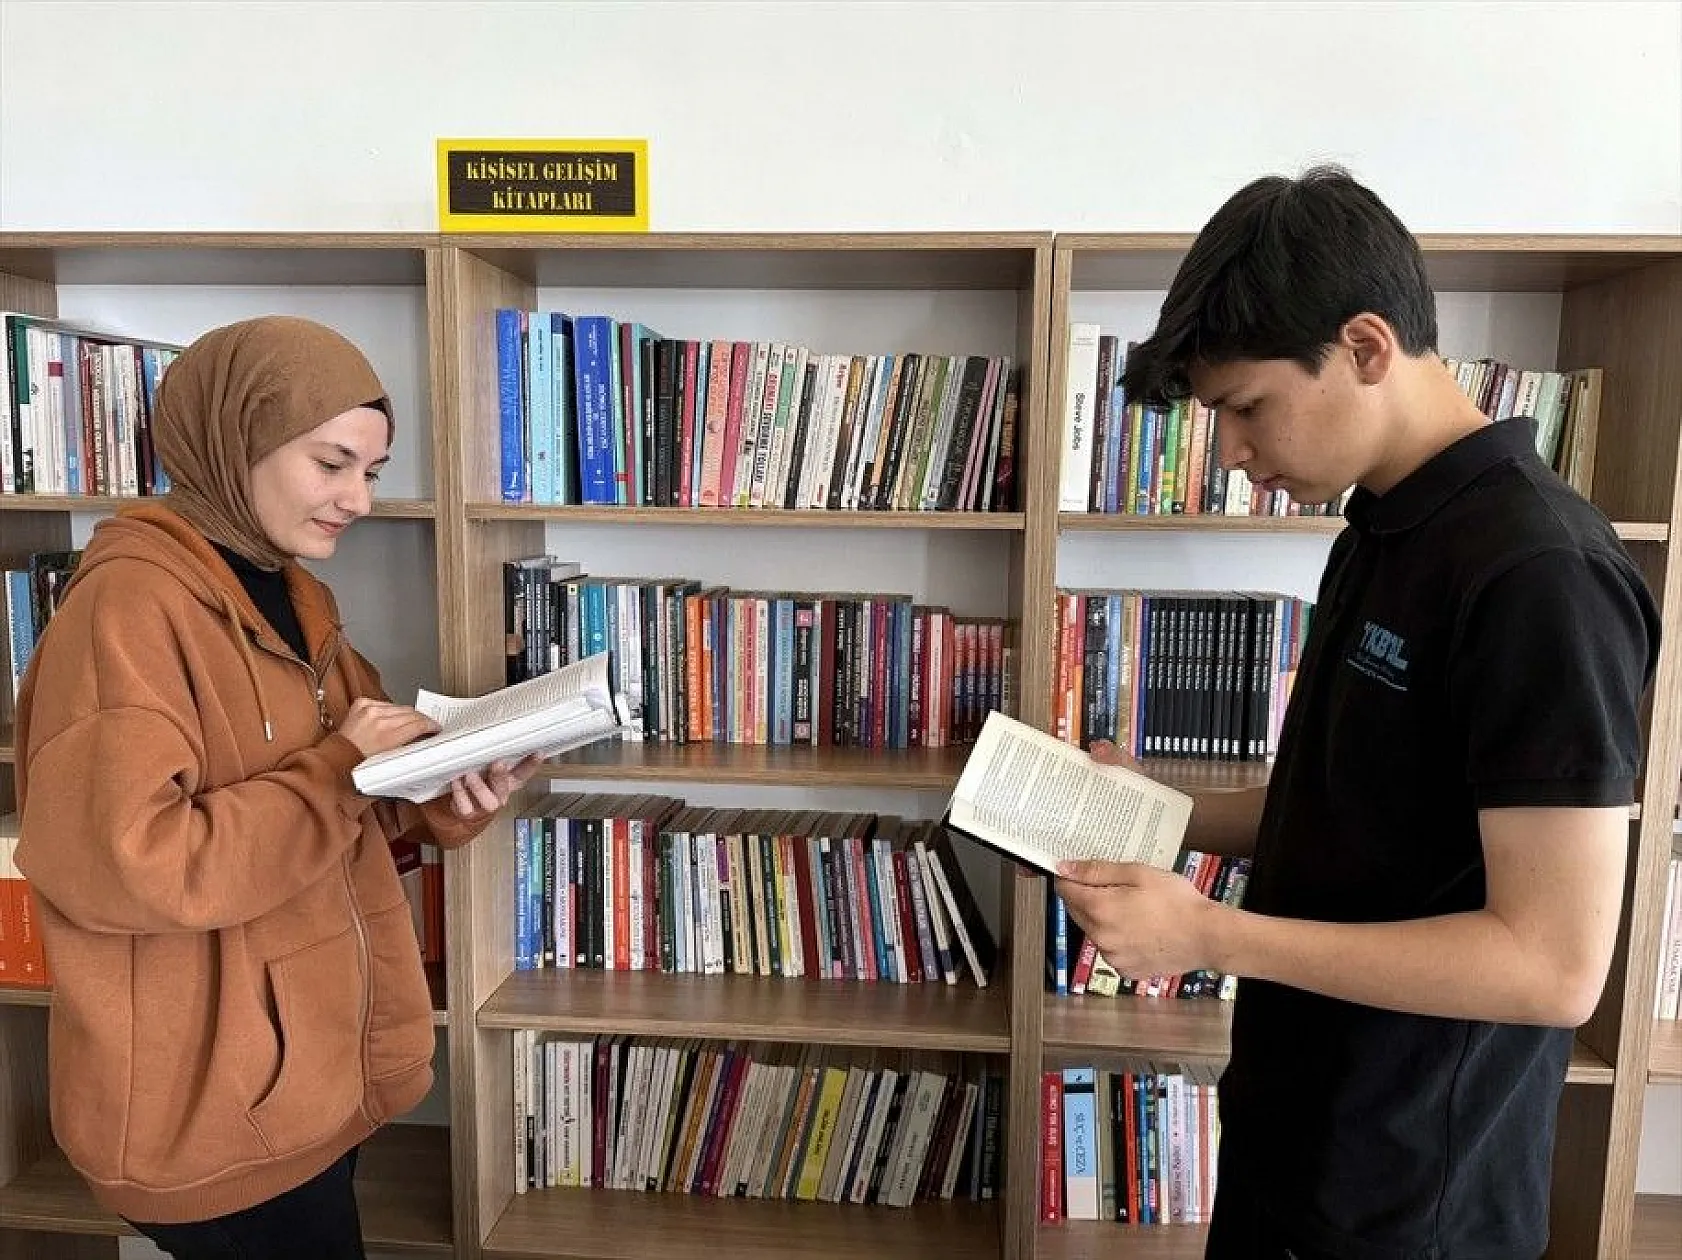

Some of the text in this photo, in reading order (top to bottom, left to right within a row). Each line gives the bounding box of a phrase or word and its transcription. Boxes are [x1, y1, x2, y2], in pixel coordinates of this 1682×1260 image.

[466, 157, 618, 185] KİŞİSEL GELİŞİM
[492, 186, 592, 211] KİTAPLARI
[1072, 392, 1086, 451] Steve Jobs
[1074, 1112, 1086, 1134] SUÇ
[1075, 1145, 1086, 1175] CEZA
